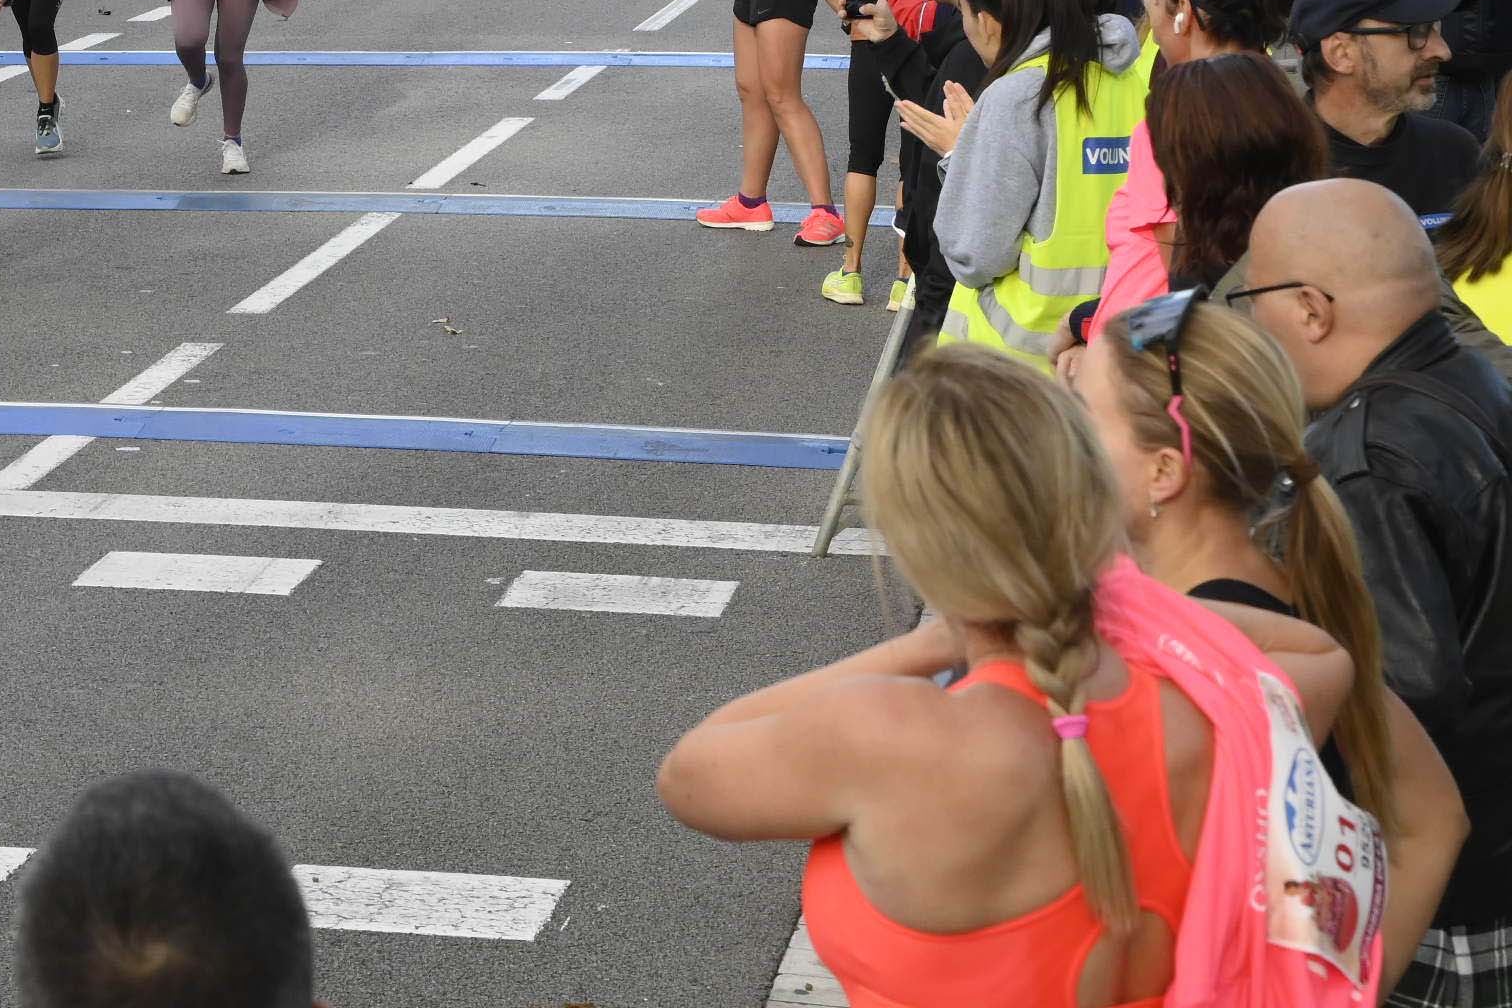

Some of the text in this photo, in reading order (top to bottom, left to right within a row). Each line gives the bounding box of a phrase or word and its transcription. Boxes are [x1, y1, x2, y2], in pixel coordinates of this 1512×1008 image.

[1085, 147, 1130, 165] VOLUN
[1300, 758, 1317, 852] ASTURIANA
[1335, 813, 1358, 874] 01
